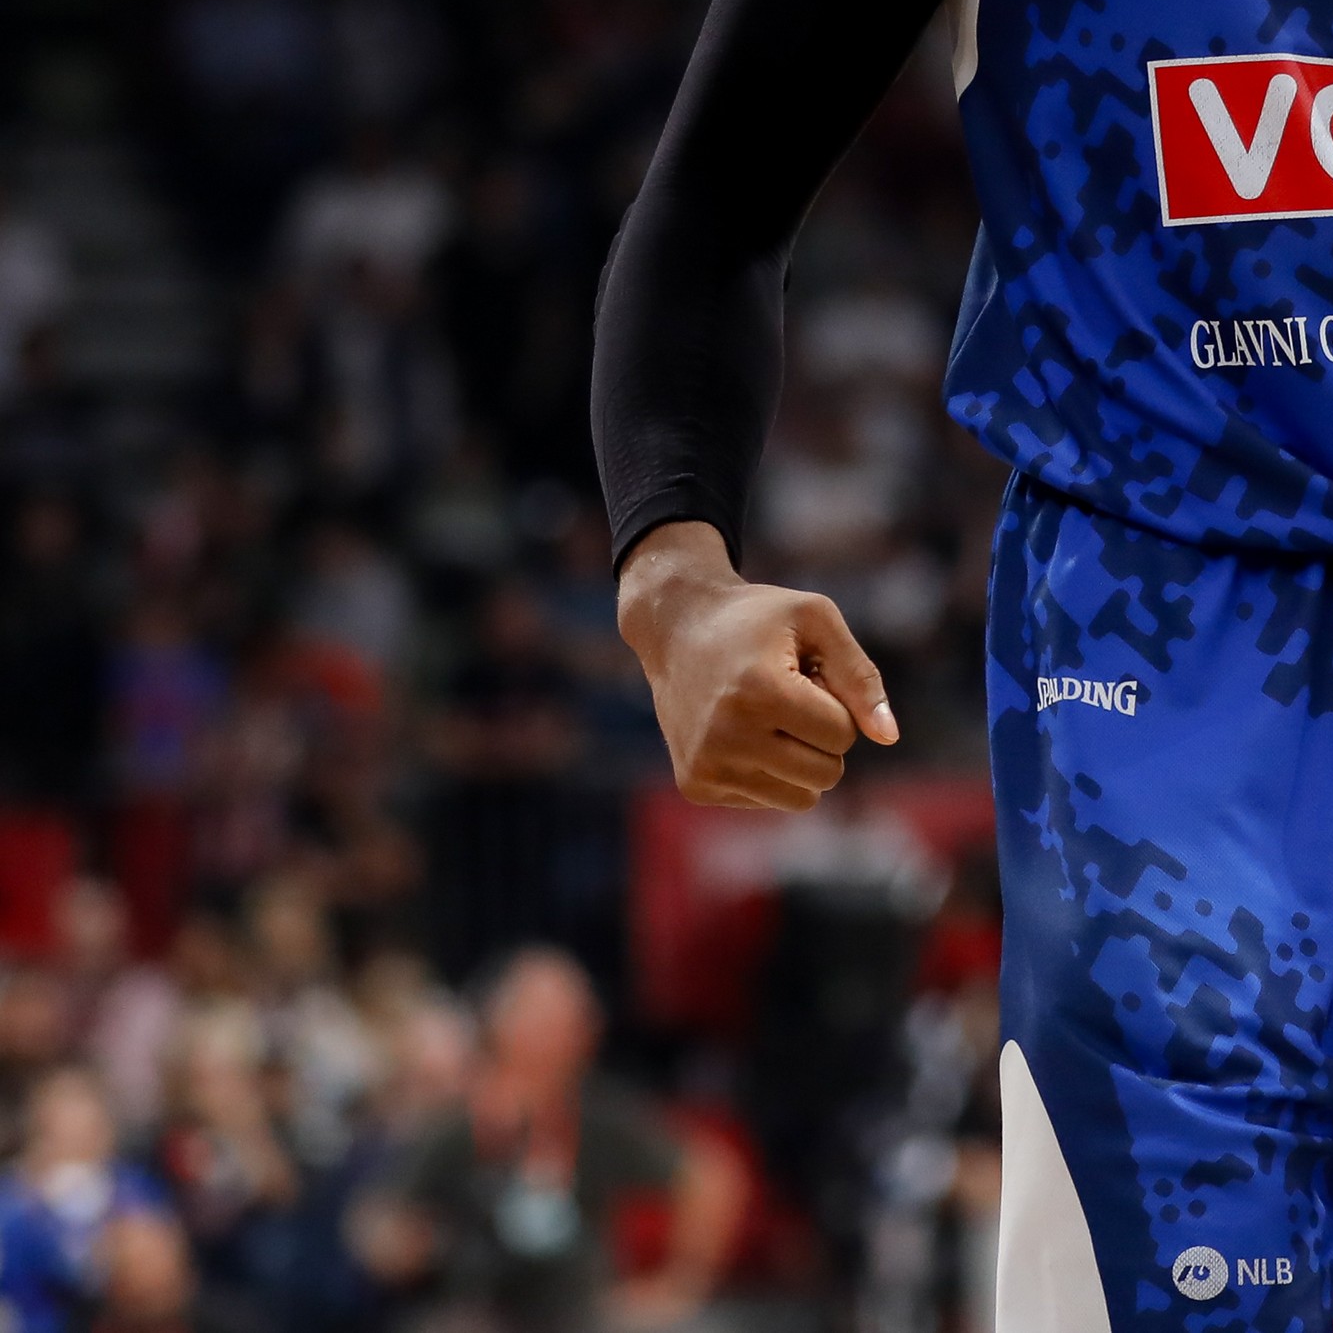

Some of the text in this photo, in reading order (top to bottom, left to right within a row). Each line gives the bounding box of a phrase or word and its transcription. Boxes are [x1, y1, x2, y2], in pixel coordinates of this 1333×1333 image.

[1190, 316, 1311, 369] GLAVNI
[1036, 676, 1138, 717] SPALDING
[1236, 1257, 1294, 1286] NLB
